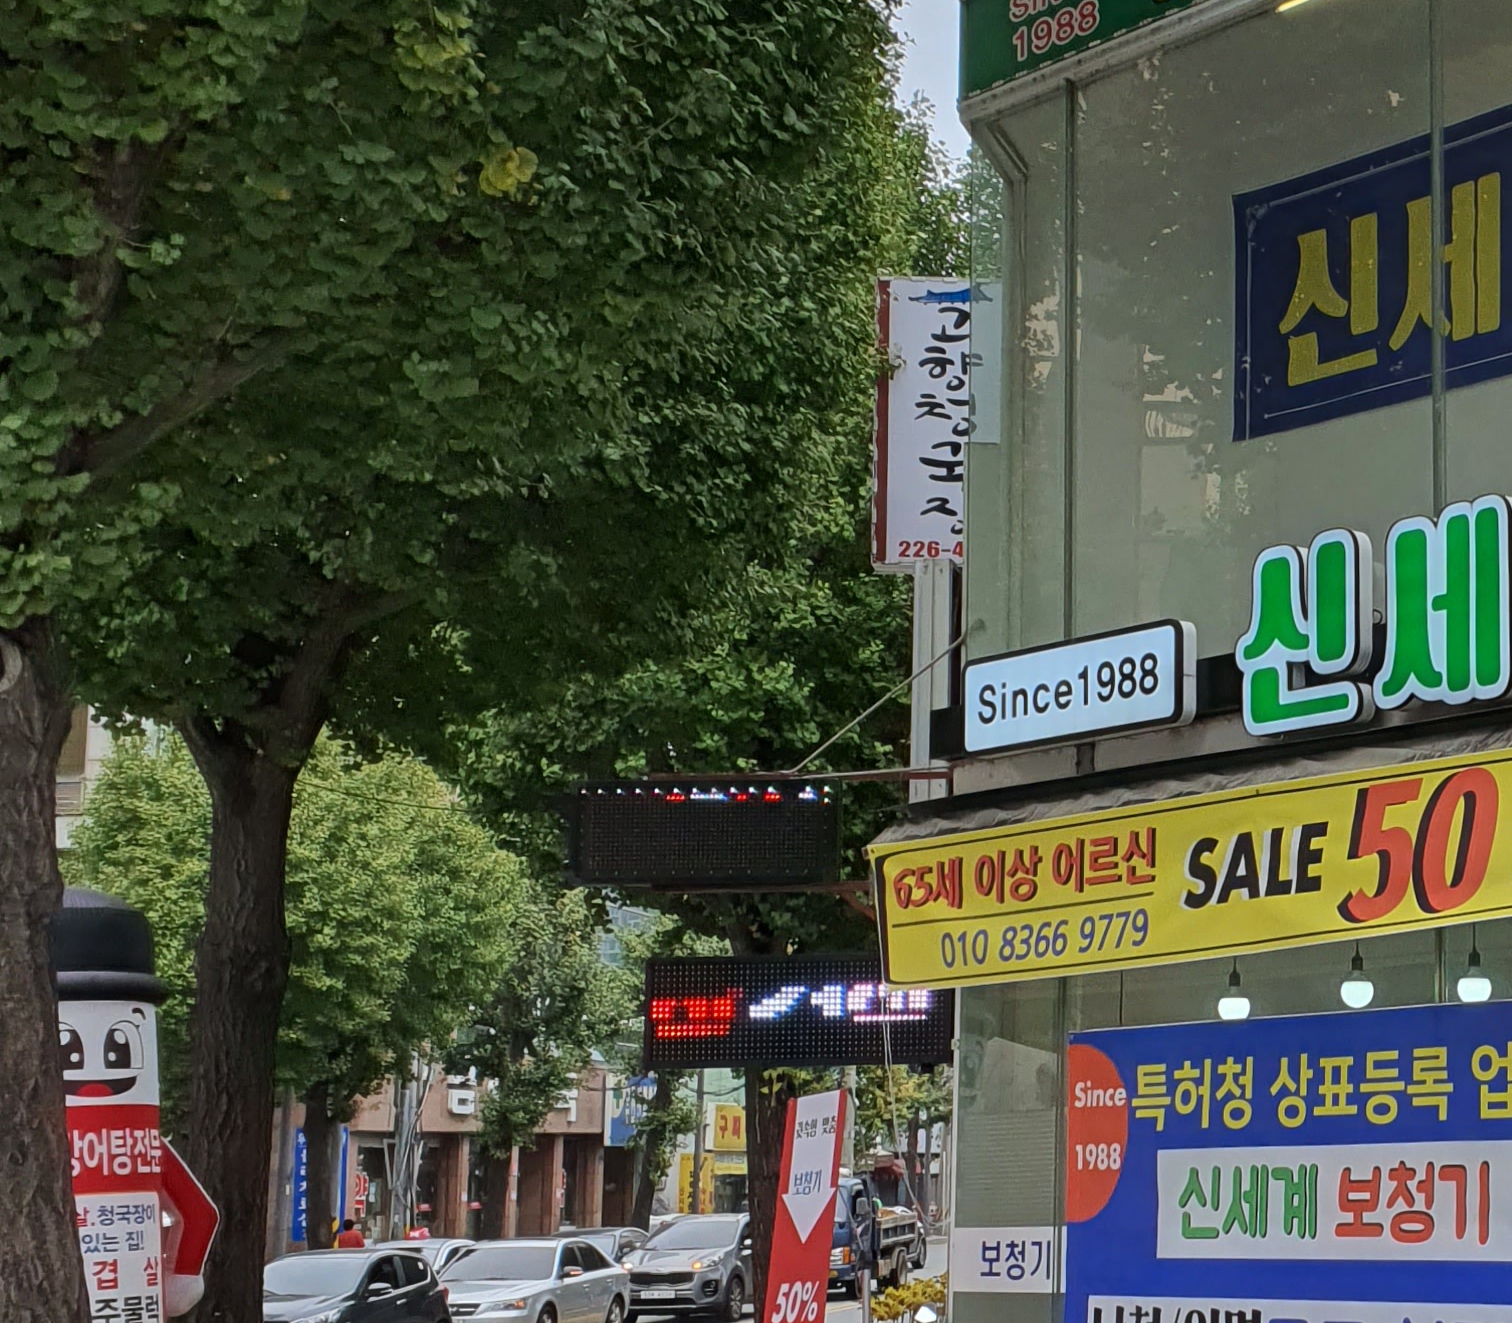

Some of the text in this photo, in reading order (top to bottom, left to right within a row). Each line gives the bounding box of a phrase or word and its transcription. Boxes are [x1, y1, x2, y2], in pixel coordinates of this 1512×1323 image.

[1012, 0, 1100, 62] 1988
[977, 653, 1160, 725] Since1988
[892, 826, 1157, 911] 65세 이상 어르신
[1182, 821, 1328, 910] SALE
[941, 908, 1149, 969] 010 8366 9779
[1074, 1081, 1127, 1108] Since
[1131, 1056, 1254, 1131] 특허청
[1270, 1046, 1454, 1129] 상표등록
[792, 1169, 822, 1195] 보청기
[1075, 1143, 1122, 1171] 1988
[97, 1204, 155, 1226] 청국장이
[1178, 1160, 1491, 1246] 신세계 보청기
[82, 1233, 119, 1254] 있는
[980, 1240, 1051, 1280] 보청기
